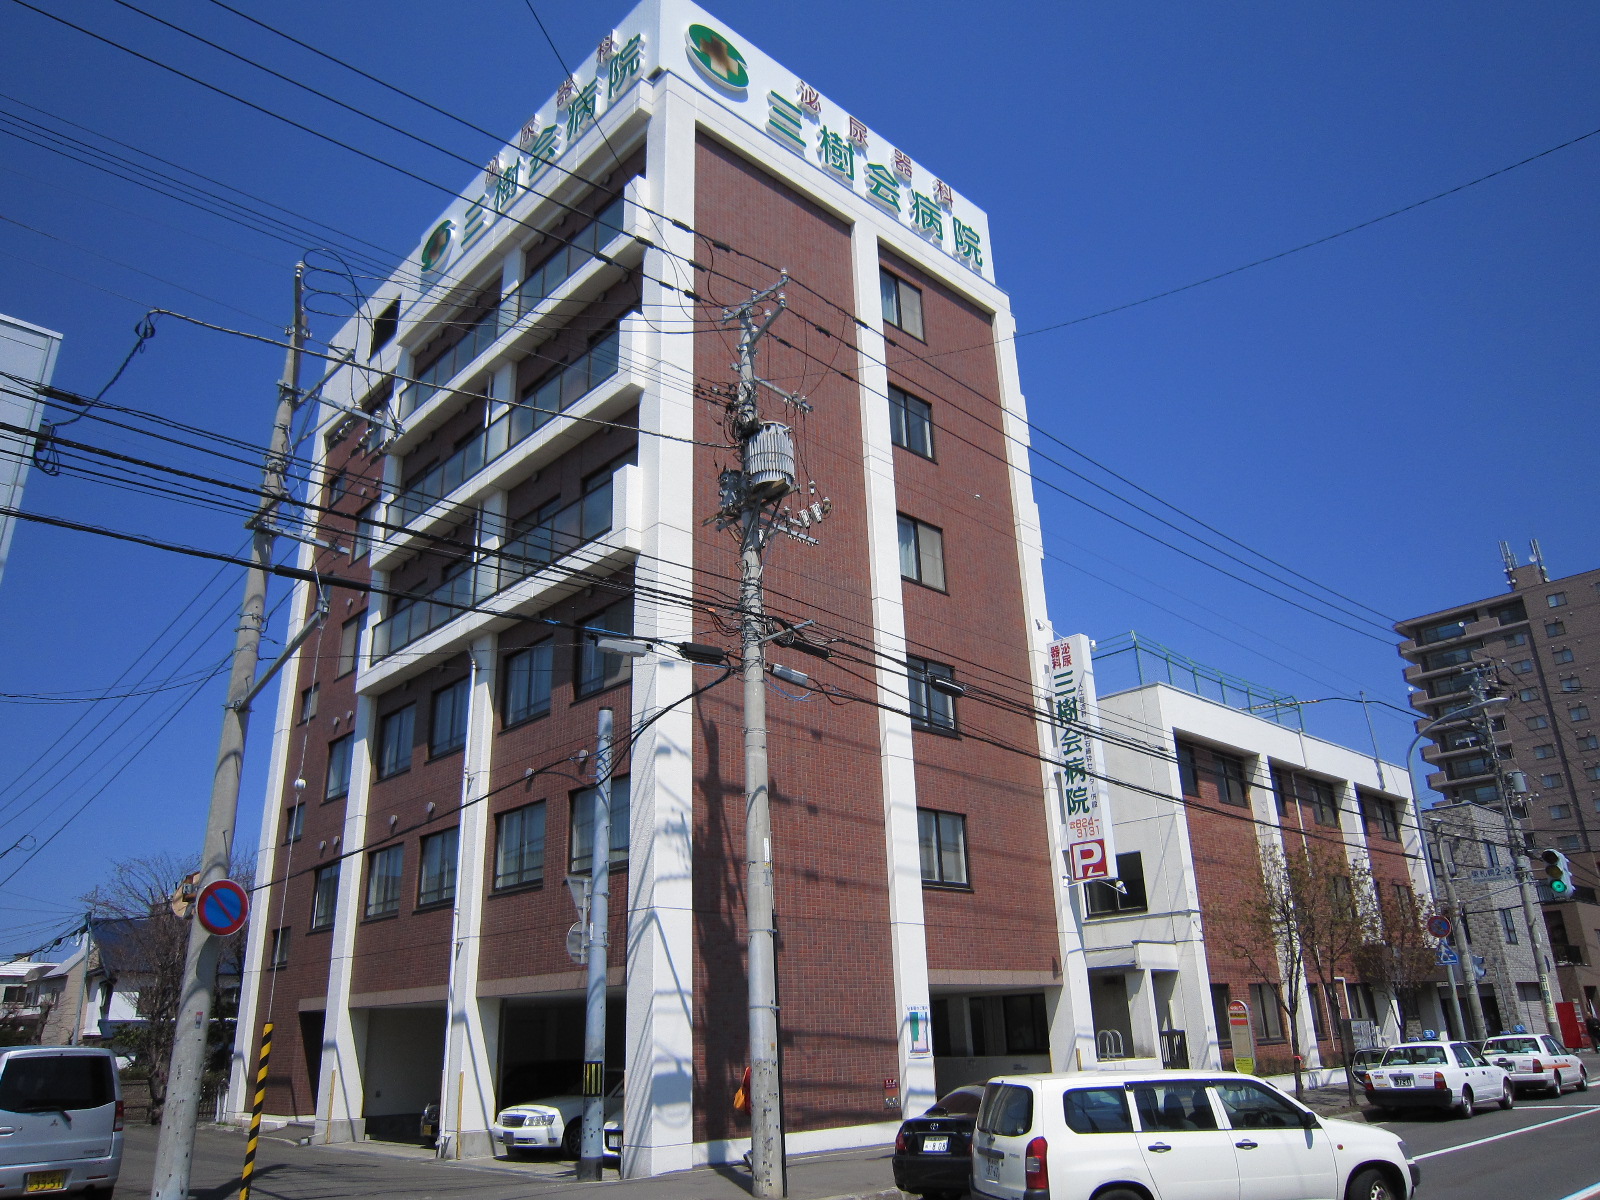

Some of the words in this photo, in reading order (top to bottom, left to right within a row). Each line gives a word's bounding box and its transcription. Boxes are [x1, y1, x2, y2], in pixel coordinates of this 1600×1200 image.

[461, 33, 643, 248] 三樹会病院
[767, 90, 983, 267] 三樹会病院
[799, 80, 954, 208] 泌尿器科
[1054, 670, 1090, 815] 三樹会病院
[1073, 842, 1102, 878] P
[1077, 825, 1100, 838] 3131
